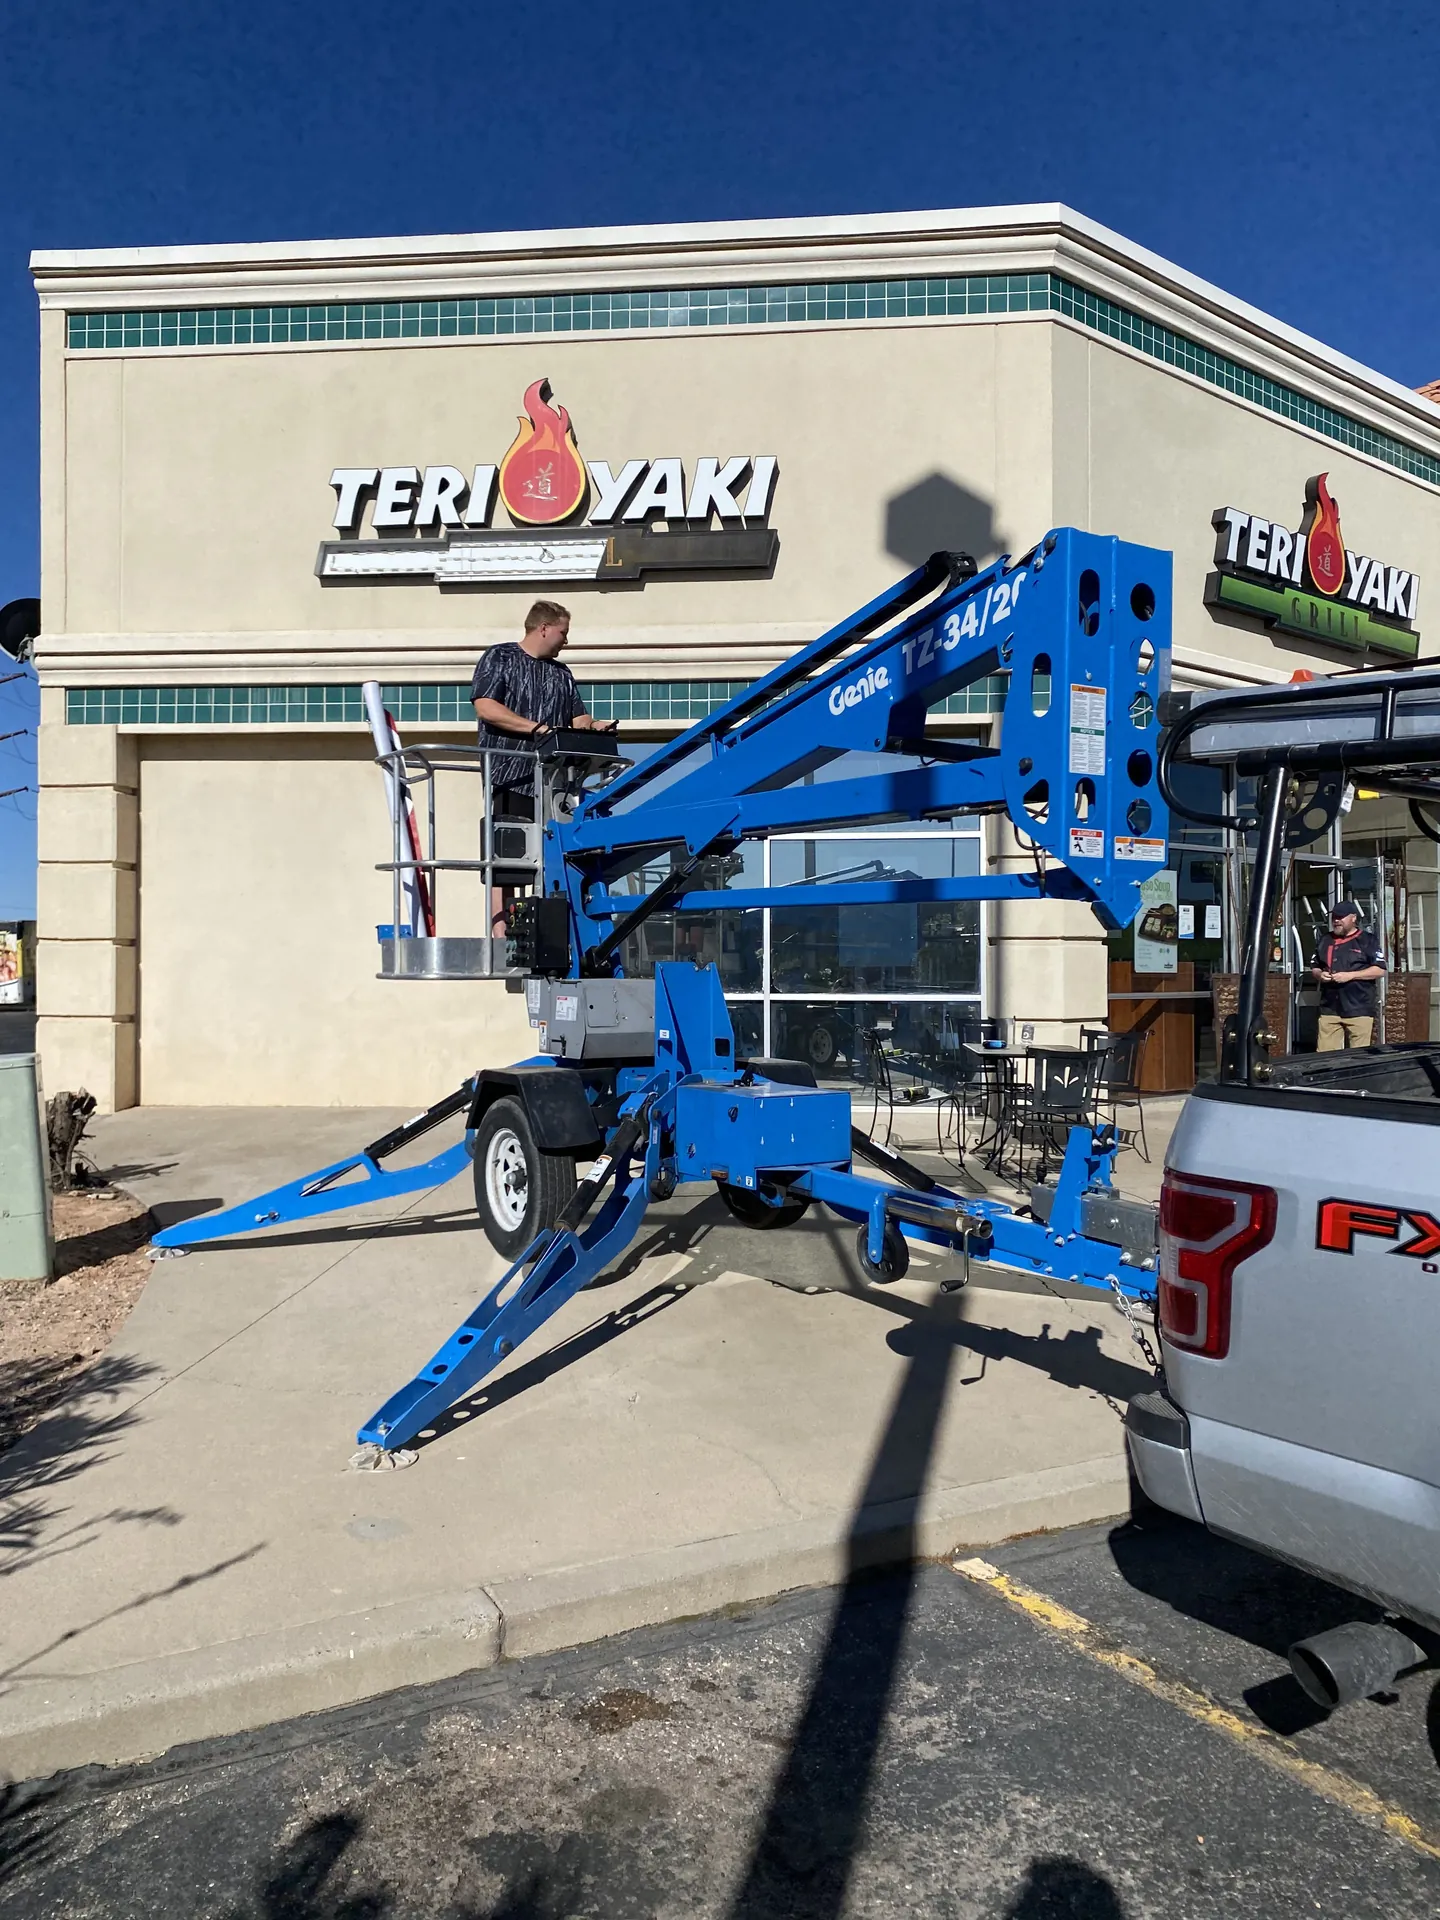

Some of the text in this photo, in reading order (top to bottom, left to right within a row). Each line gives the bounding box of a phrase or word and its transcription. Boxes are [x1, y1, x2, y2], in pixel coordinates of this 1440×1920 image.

[329, 464, 499, 528] TERI
[587, 456, 778, 525] YAKI
[1224, 506, 1307, 586] TERI
[1346, 550, 1421, 620] YAKI
[1291, 597, 1362, 641] GRILL
[829, 667, 889, 716] Genie
